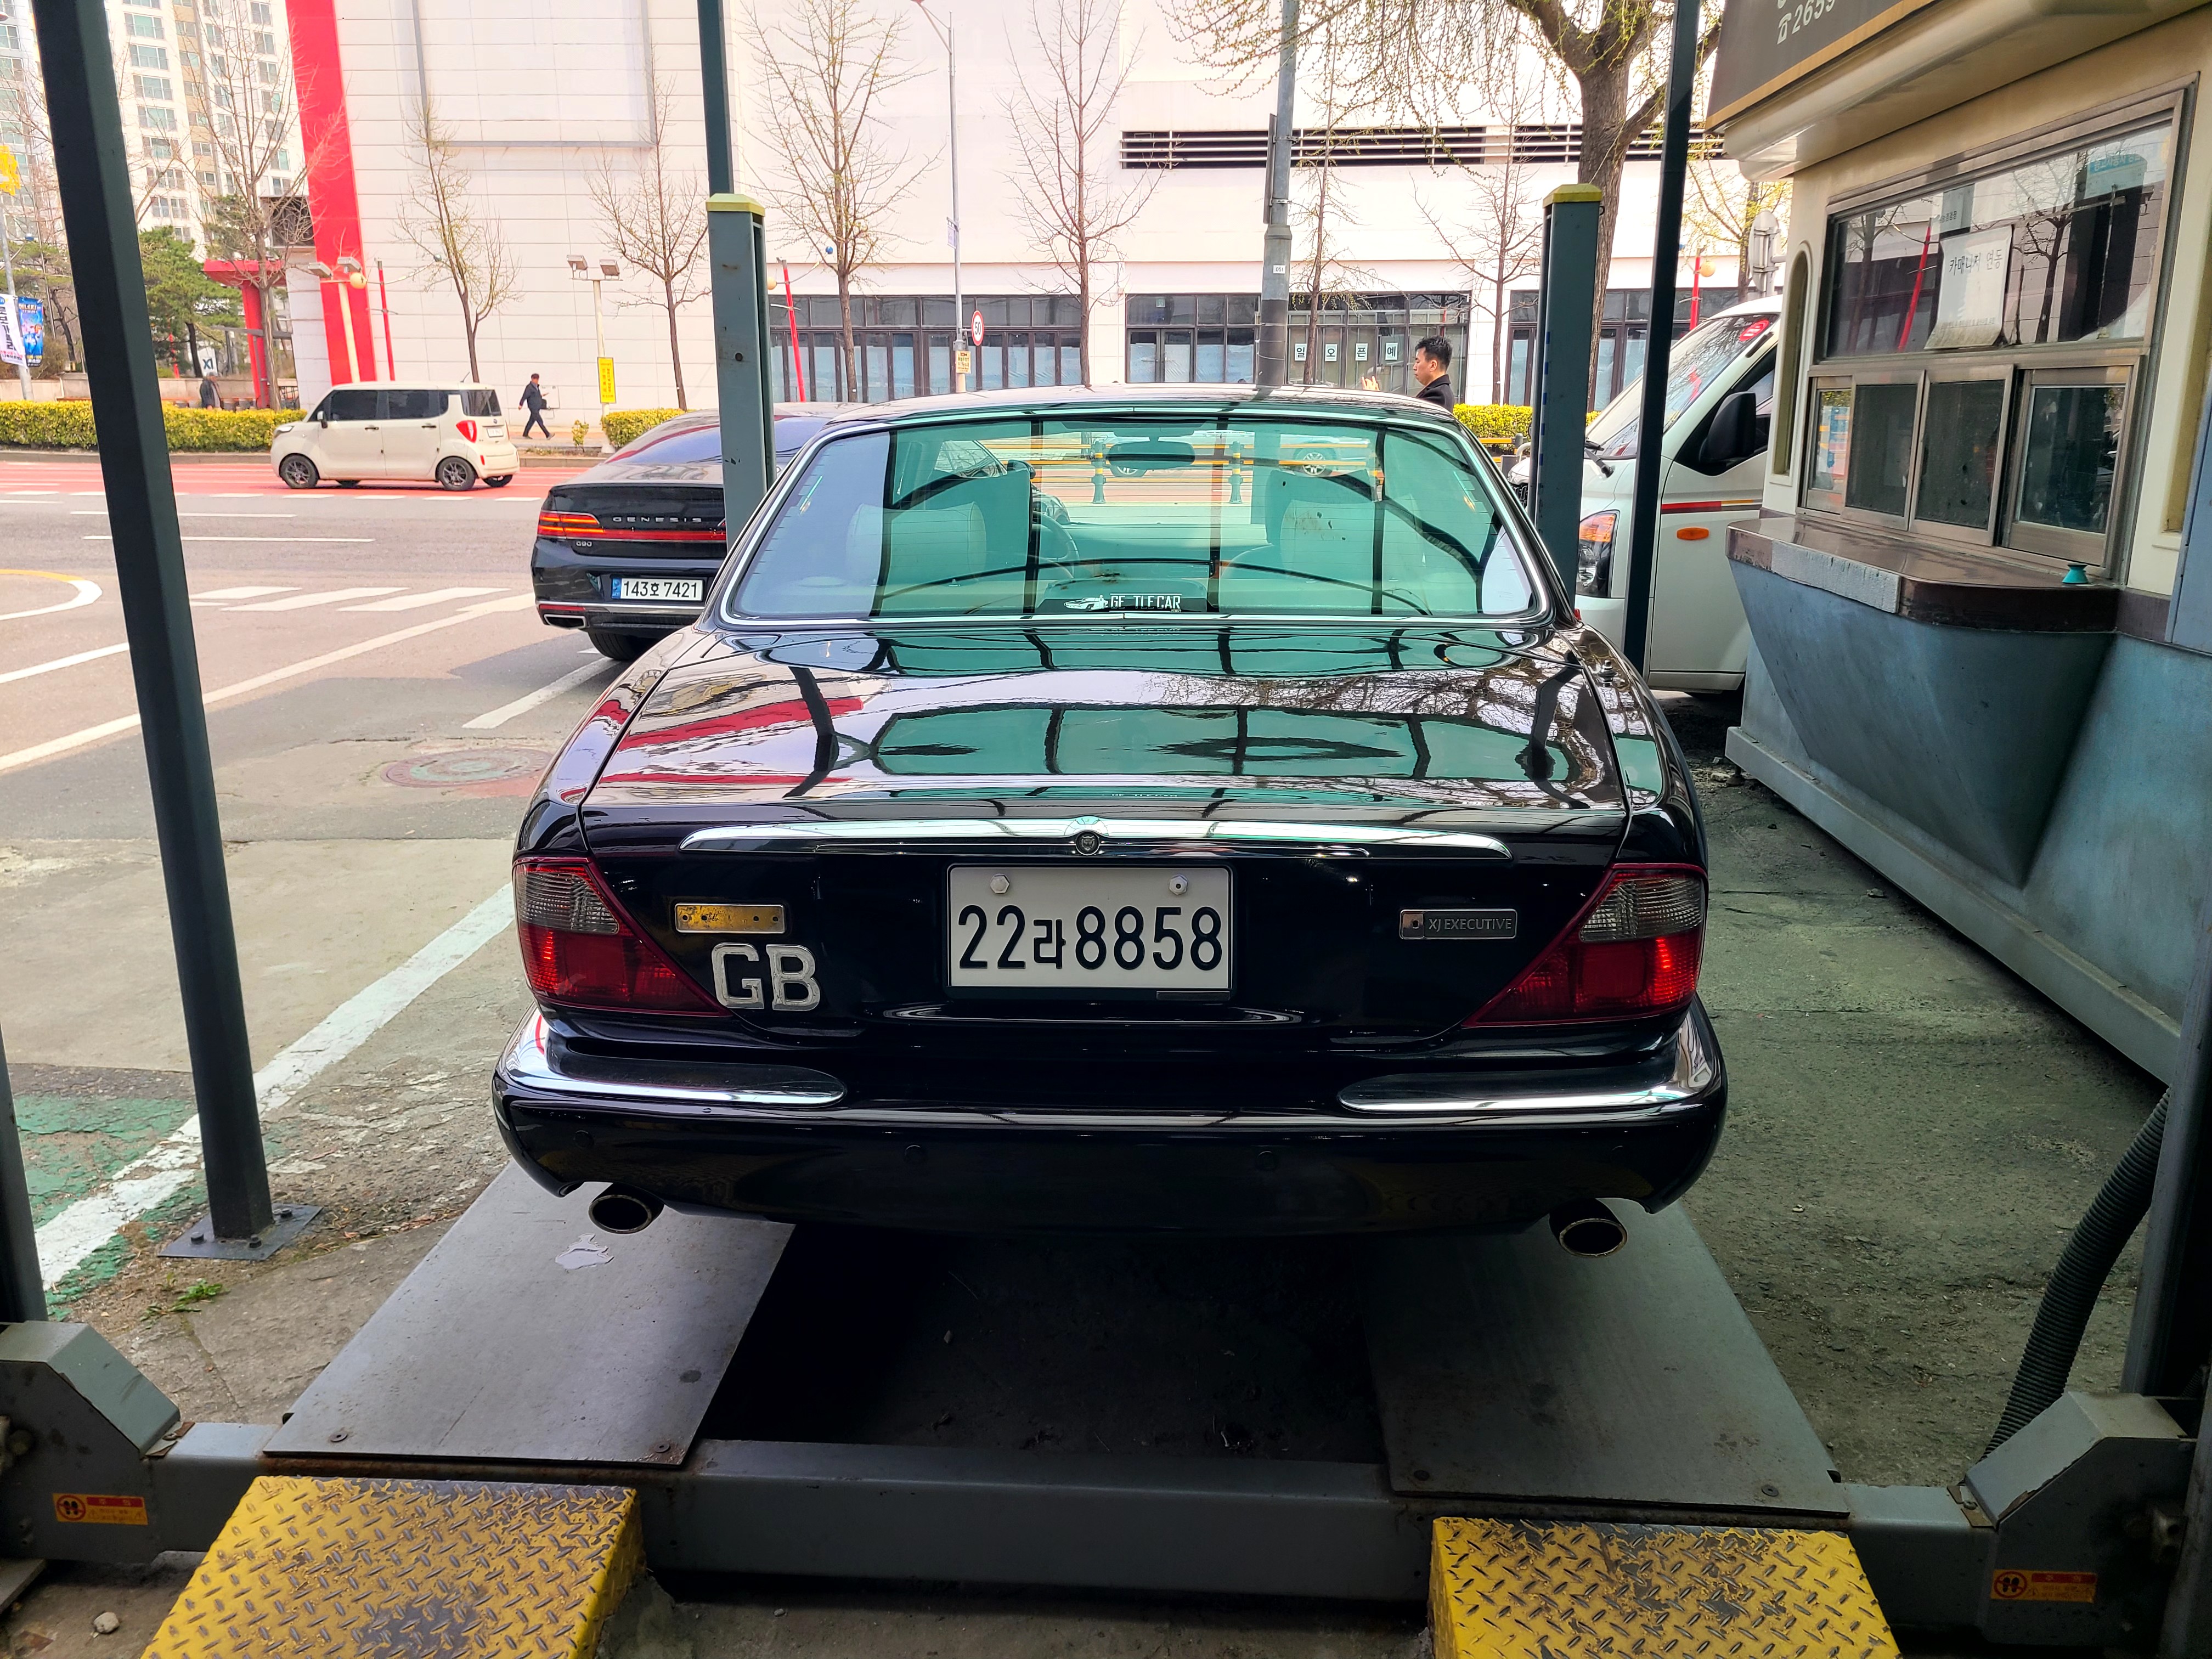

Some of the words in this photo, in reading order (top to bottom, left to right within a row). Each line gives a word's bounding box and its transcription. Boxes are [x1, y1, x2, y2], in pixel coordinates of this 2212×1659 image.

[1949, 252, 1981, 275] 카매니저
[1987, 249, 2002, 270] 연동
[974, 321, 981, 335] 50
[624, 581, 660, 597] 143호
[663, 582, 697, 598] 7421
[1429, 919, 1441, 932] XJ
[1444, 919, 1513, 930] EXECUTIVE
[958, 905, 1223, 971] 22라8858
[712, 942, 821, 1012] GB
